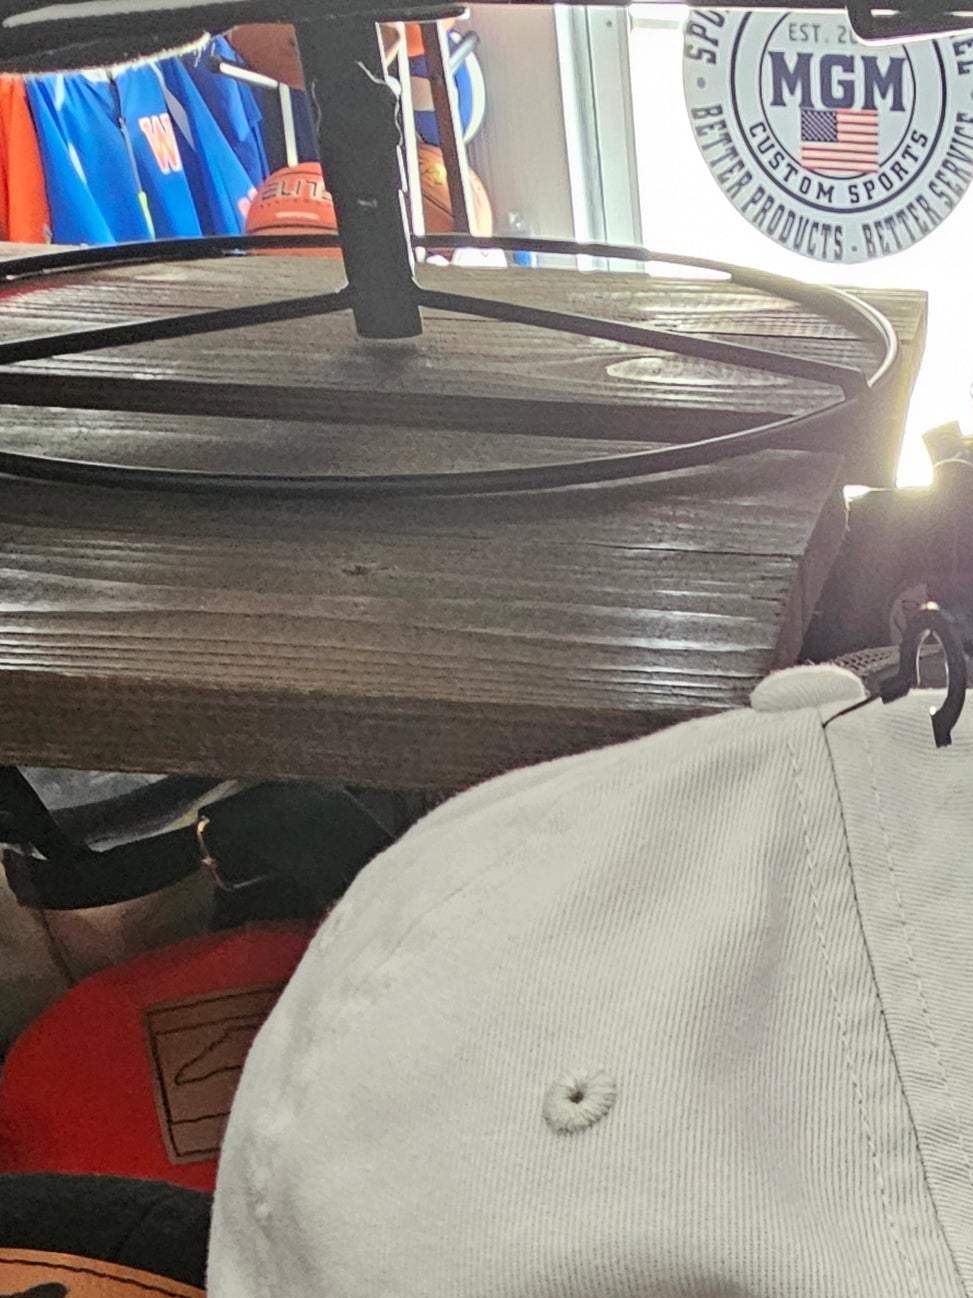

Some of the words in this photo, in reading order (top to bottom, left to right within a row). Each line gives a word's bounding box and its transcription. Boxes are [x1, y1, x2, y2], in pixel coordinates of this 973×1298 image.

[788, 23, 829, 43] EST.
[769, 51, 906, 111] MGM
[138, 112, 183, 175] W
[750, 121, 834, 203] CUSTOM
[848, 130, 929, 204] SPORTS
[691, 104, 753, 199] BETTER
[741, 184, 844, 261] PRODUCTS
[862, 194, 944, 258] BETTER
